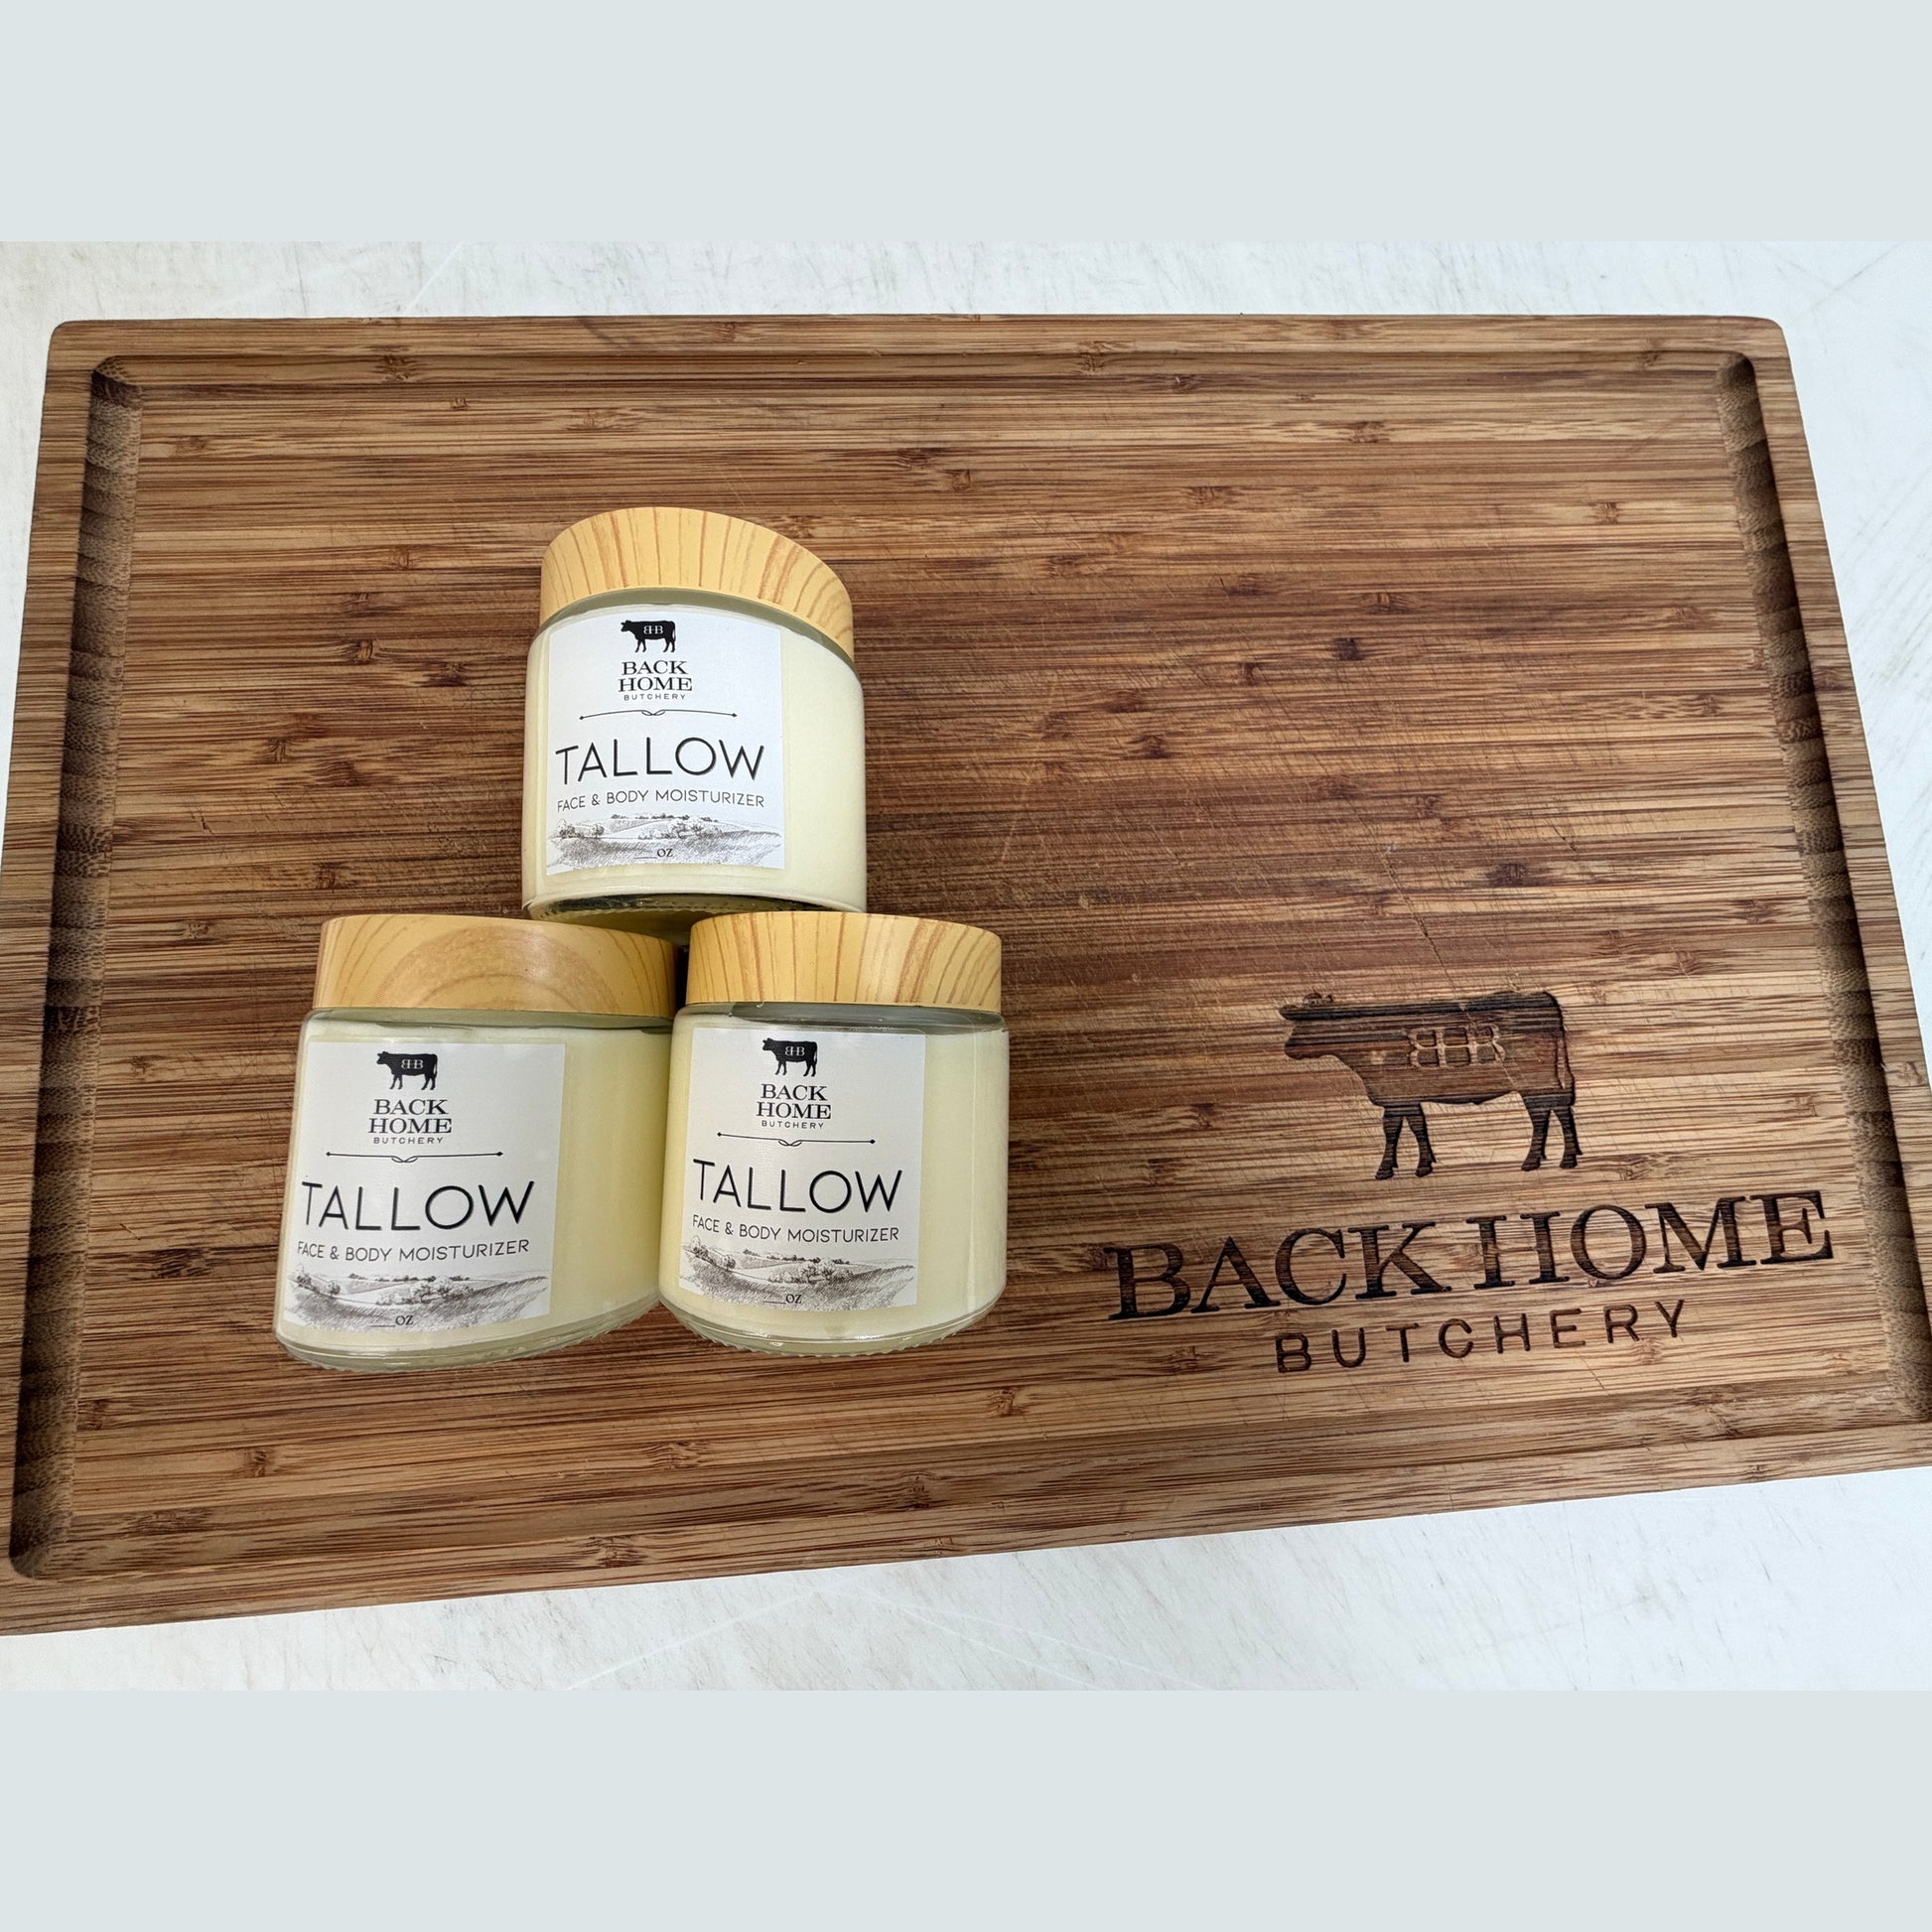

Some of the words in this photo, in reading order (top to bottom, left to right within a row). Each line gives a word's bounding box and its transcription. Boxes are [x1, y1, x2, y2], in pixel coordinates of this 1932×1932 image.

[621, 660, 689, 676] BACK
[618, 677, 693, 693] HOME
[555, 737, 764, 785] TALLOW
[557, 795, 586, 813] FACE
[591, 793, 601, 805] &
[607, 789, 649, 804] BODY
[655, 788, 764, 807] MOISTURIZER
[760, 1083, 828, 1101] BACK
[372, 1098, 449, 1115] BACK
[756, 1101, 832, 1120] HOME
[367, 1118, 453, 1134] HOME
[760, 1120, 825, 1130] BUTCHERY
[373, 1136, 445, 1145] BUTCHERY
[693, 1158, 902, 1213] TALLOW
[302, 1180, 535, 1231] TALLOW
[692, 1213, 720, 1233] FACE
[725, 1221, 735, 1235] &
[740, 1223, 781, 1240] BODY
[787, 1227, 899, 1243] MOISTURIZER
[297, 1240, 324, 1259] FACE
[330, 1246, 340, 1260] &
[345, 1246, 392, 1262] BODY
[398, 1239, 530, 1262] MOISTURIZER
[1102, 1220, 1452, 1322] BACK
[1466, 1190, 1835, 1291] HOME
[1276, 1298, 1689, 1374] BUTCHERY
